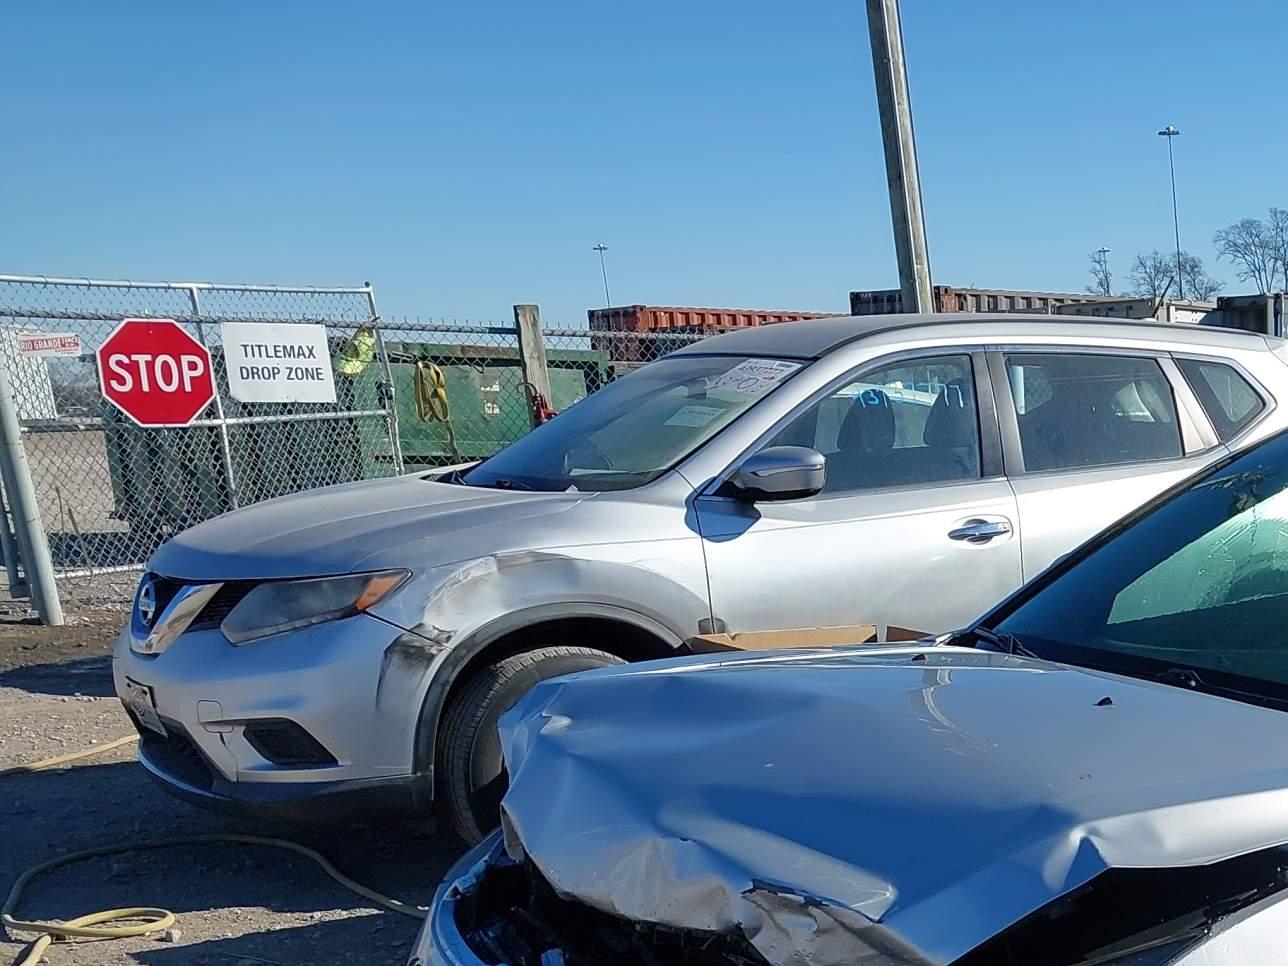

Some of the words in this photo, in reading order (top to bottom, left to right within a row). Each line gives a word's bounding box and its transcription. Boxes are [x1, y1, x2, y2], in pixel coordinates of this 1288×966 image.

[20, 341, 33, 351] RIO
[34, 338, 61, 350] GRANDE
[240, 343, 316, 360] TITLEMAX
[108, 353, 205, 394] STOP
[239, 366, 281, 382] DROP
[286, 366, 325, 382] ZONE
